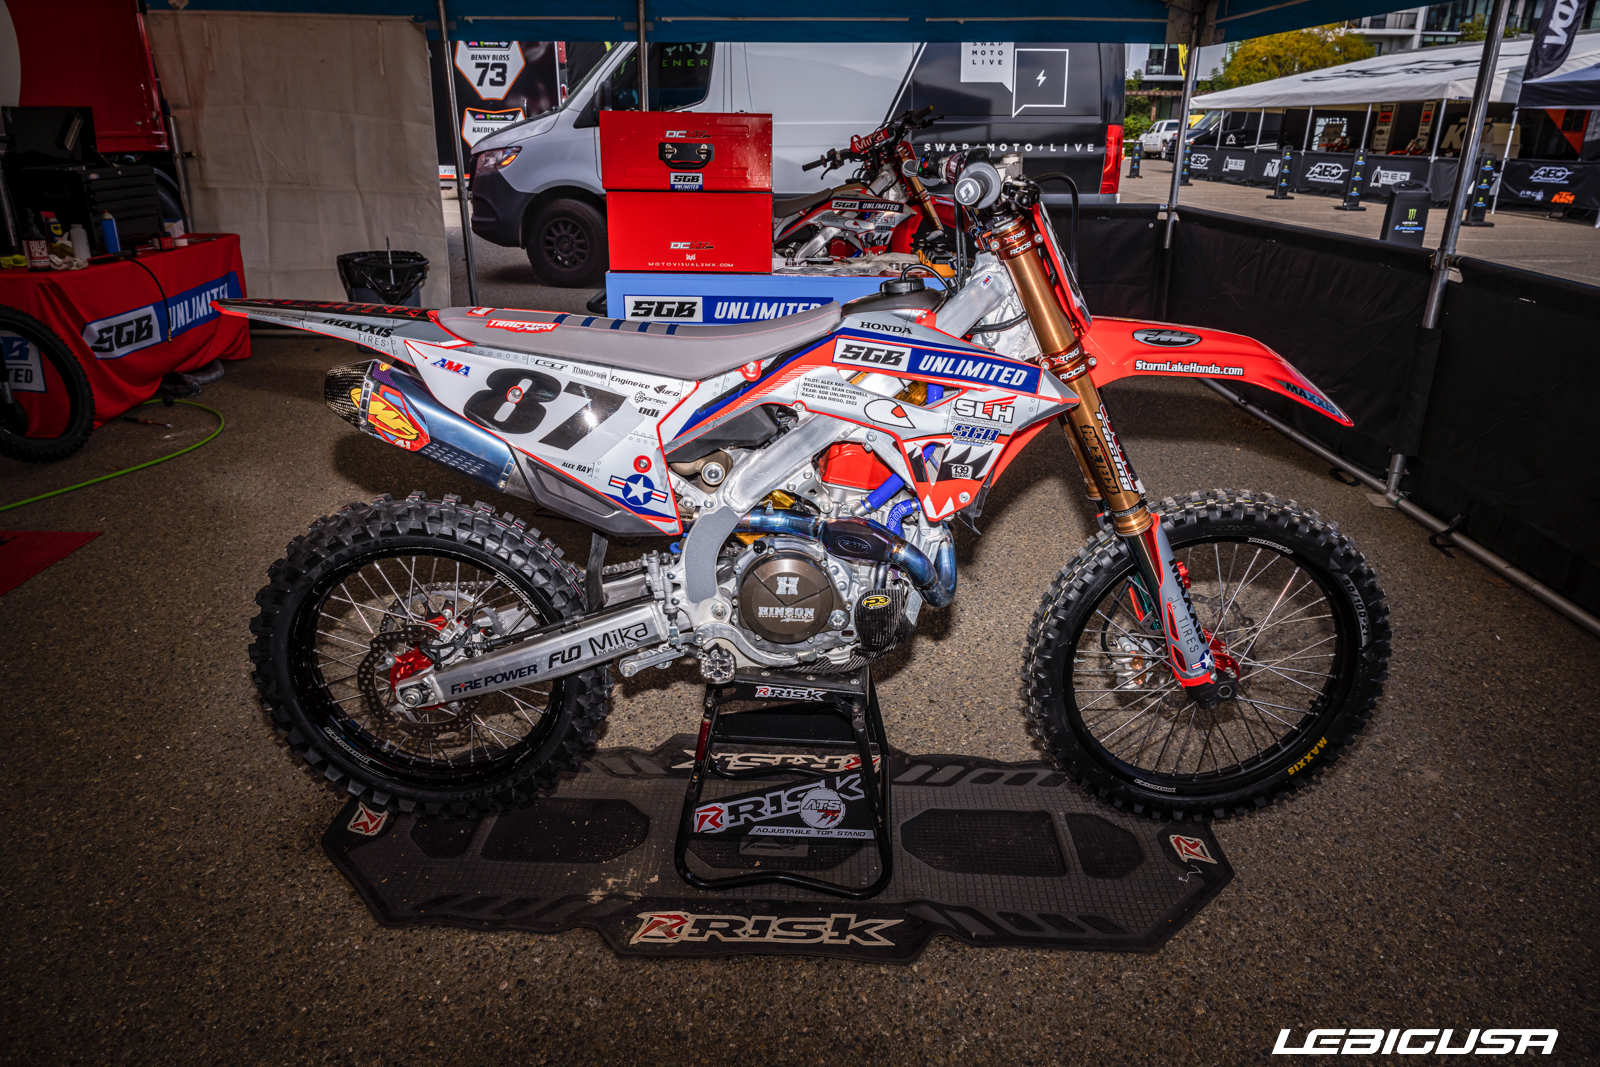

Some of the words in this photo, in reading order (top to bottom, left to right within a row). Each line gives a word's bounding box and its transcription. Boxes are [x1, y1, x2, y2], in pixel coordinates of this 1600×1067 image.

[475, 62, 508, 87] 73
[924, 143, 969, 152] SWAP
[987, 143, 1033, 152] MOTO
[1050, 143, 1094, 152] LIVE
[1263, 158, 1281, 177] KT
[672, 175, 700, 183] SGB
[833, 201, 858, 209] SGB
[862, 202, 900, 211] UNLIMITED
[1551, 191, 1575, 204] KTM
[1003, 229, 1026, 243] XTRIG
[1010, 241, 1032, 256] ROCS
[631, 301, 697, 318] SGB
[90, 314, 153, 352] SGB
[322, 317, 396, 338] MAXXIS
[861, 321, 913, 335] HONDA
[357, 332, 388, 347] TIRES
[838, 344, 906, 367] SGB
[918, 354, 1028, 386] UNLIMITED
[1051, 348, 1080, 365] XTRIG
[430, 357, 471, 377] AMA
[1059, 363, 1086, 381] ROCS
[1135, 360, 1244, 376] StormLakeHonda.com
[803, 382, 830, 391] MECHANIC:
[828, 396, 845, 404] DIEGO,
[830, 391, 857, 400] UNLIMITED
[1285, 381, 1337, 414] MAXXIS
[463, 368, 630, 451] 87
[953, 398, 1015, 423] SLH
[952, 423, 1001, 442] SGB
[1095, 411, 1132, 492] racing
[561, 461, 575, 470] ALEX
[576, 463, 593, 474] RAY
[952, 465, 969, 475] 139
[758, 606, 815, 616] HINSON
[588, 622, 648, 657] Mika
[1179, 614, 1200, 654] TIRES
[548, 644, 582, 669] FLO
[451, 677, 482, 695] FIRE
[484, 664, 538, 687] POWER
[768, 687, 828, 702] RISK
[1287, 736, 1328, 776] MAXXIS
[756, 827, 812, 835] ADJUSTABLE
[688, 913, 904, 946] RISK
